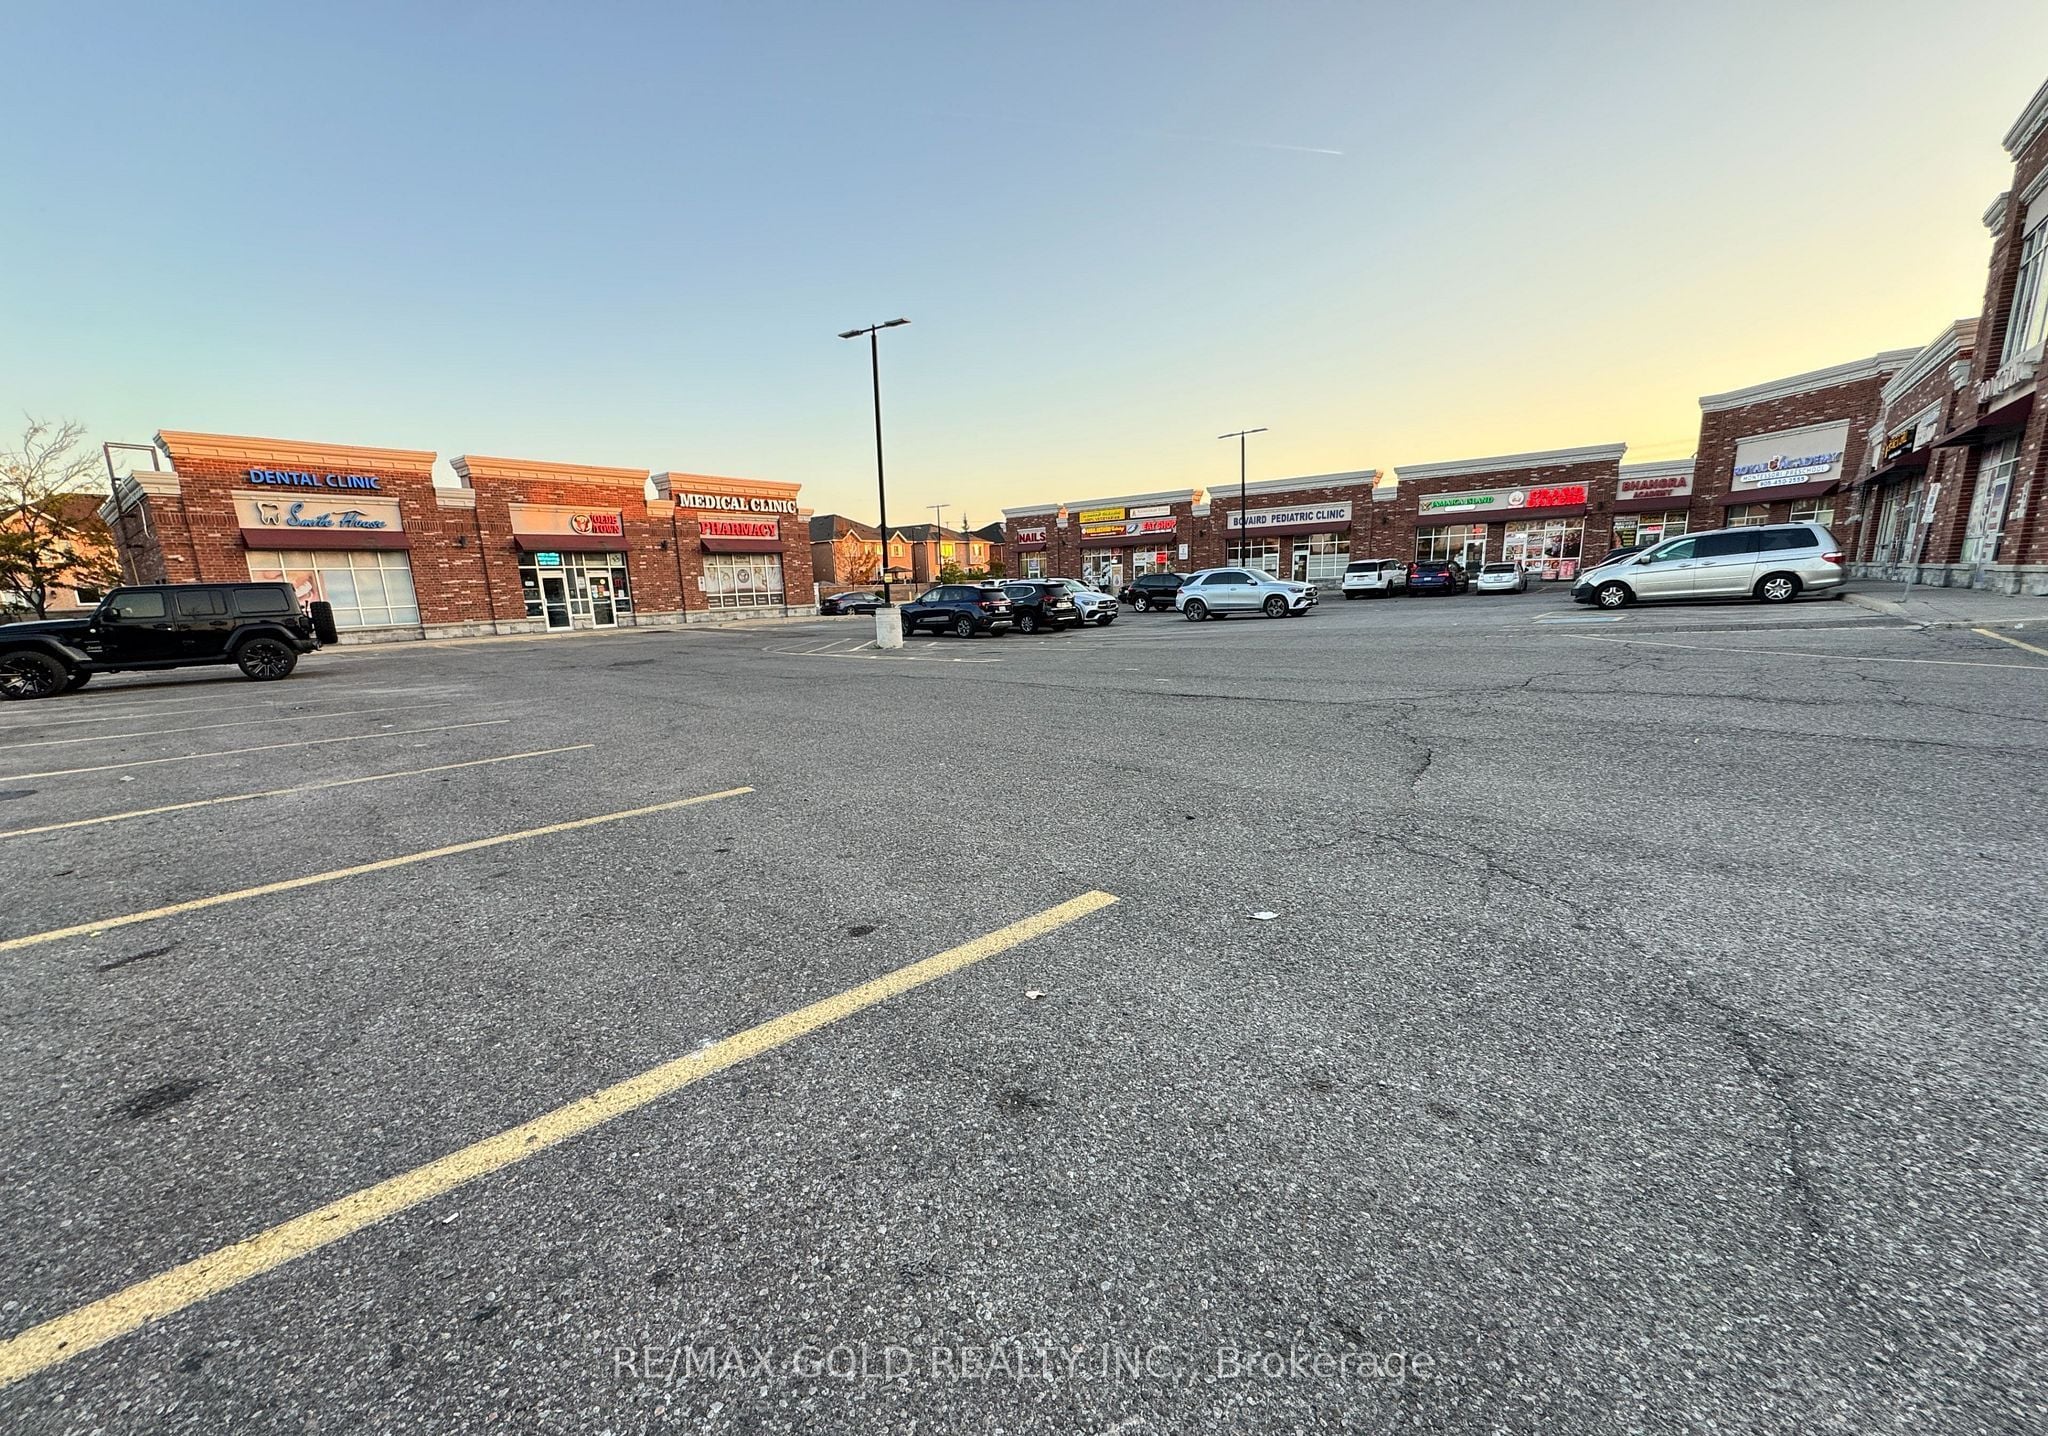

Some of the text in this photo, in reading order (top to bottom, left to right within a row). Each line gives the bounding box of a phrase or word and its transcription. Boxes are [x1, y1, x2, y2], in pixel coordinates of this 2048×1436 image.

[1785, 466, 1825, 477] PRESCHOOL
[250, 470, 381, 489] DENTAL CLINIC
[1622, 477, 1687, 491] BHANGRA
[1633, 489, 1673, 499] ACADEMY
[678, 493, 797, 513] MEDICAL CLINIC
[287, 501, 387, 528] Smile House
[1271, 511, 1314, 523] PEDIATRIC
[1316, 509, 1345, 519] CLINIC
[593, 525, 620, 534] TOWN
[701, 521, 776, 537] PHARMACY
[1019, 531, 1047, 542] NAILS
